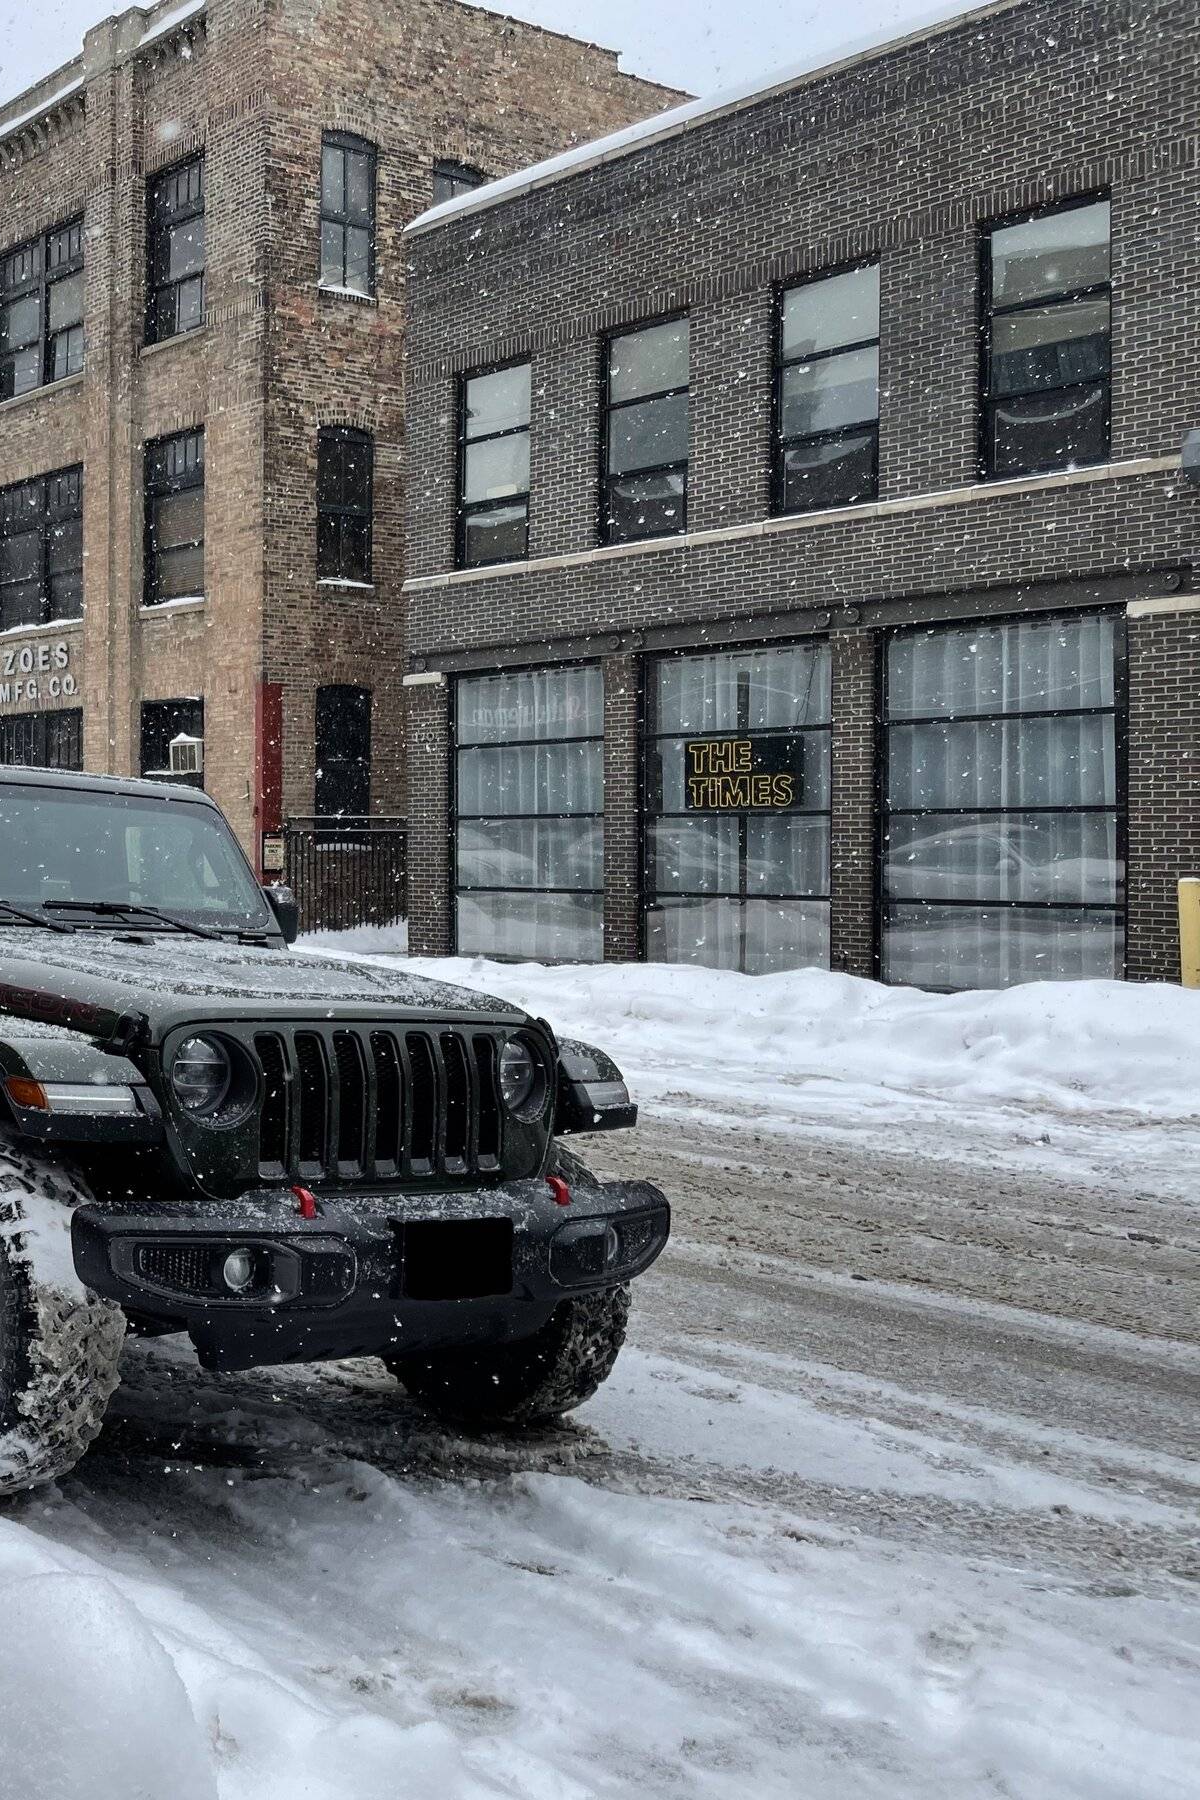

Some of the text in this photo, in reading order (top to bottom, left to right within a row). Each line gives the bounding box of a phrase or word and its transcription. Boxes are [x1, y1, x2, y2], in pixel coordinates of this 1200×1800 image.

[3, 642, 69, 676] ZOES
[688, 741, 752, 774] THE
[688, 774, 793, 808] TIMES
